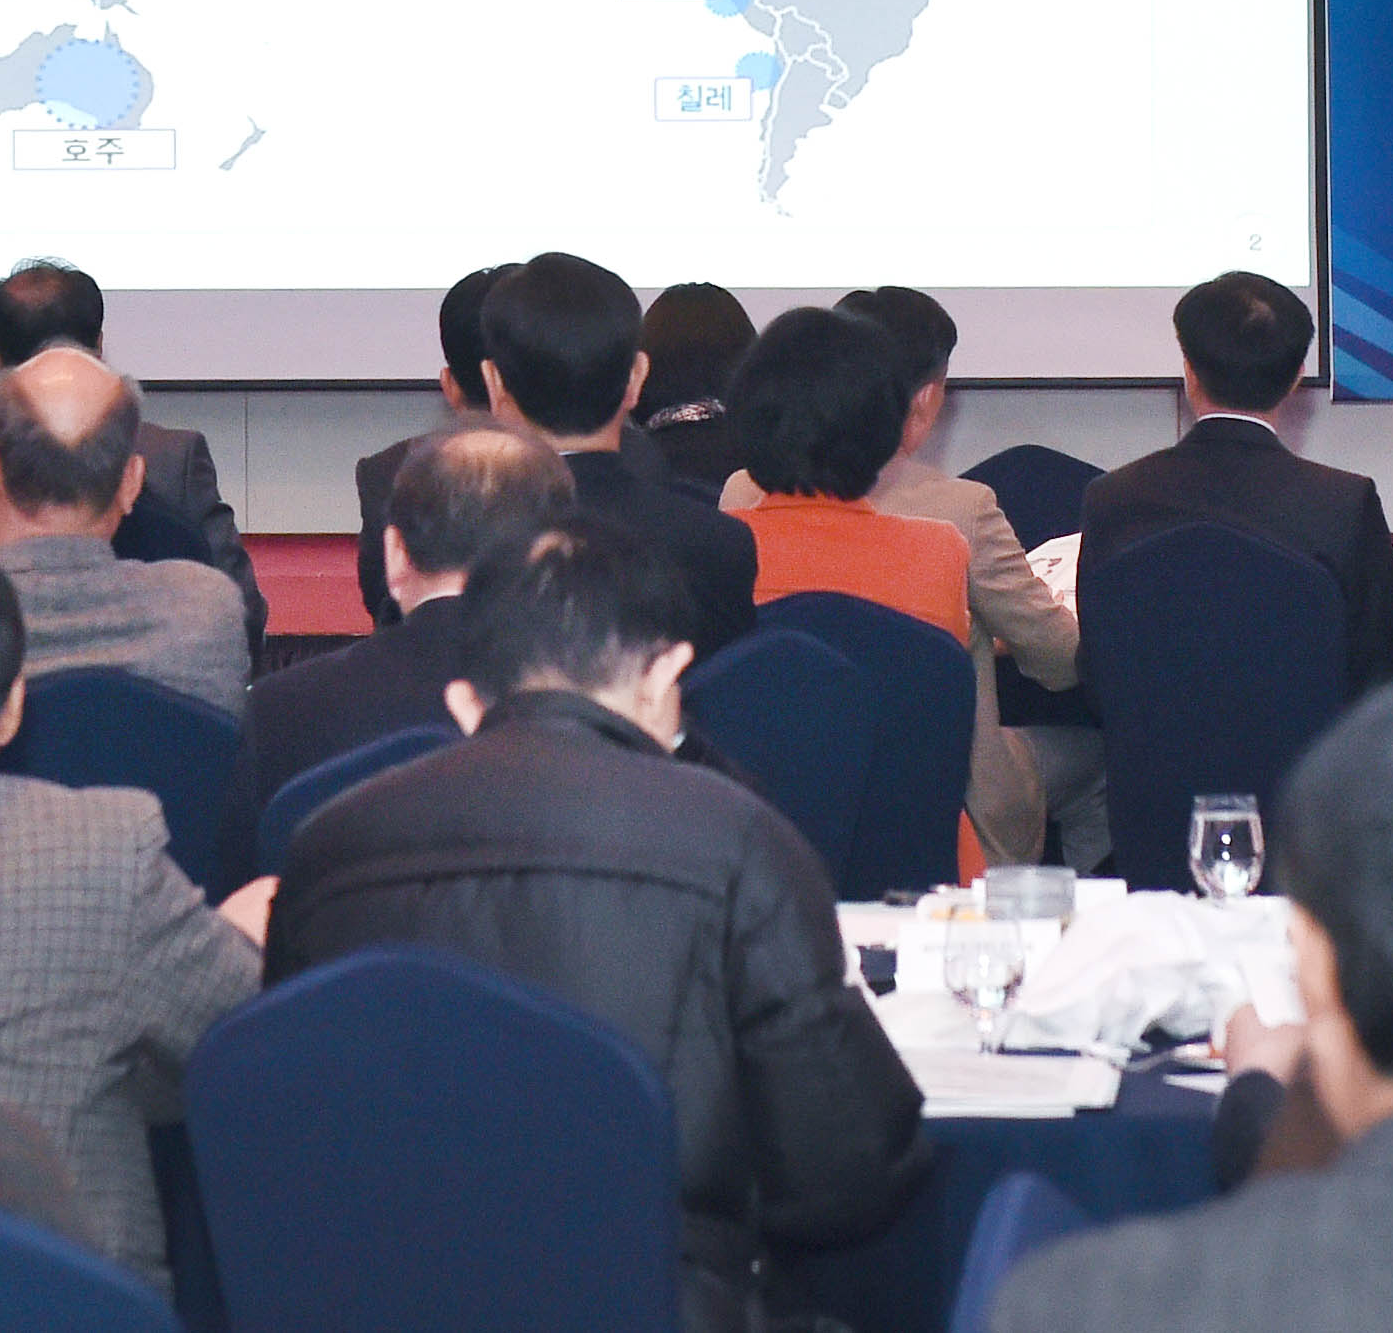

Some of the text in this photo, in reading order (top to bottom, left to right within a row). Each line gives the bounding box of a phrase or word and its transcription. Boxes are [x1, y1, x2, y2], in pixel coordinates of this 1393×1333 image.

[678, 85, 731, 112] 칠레
[63, 138, 124, 164] 호주
[1250, 234, 1262, 251] 2
